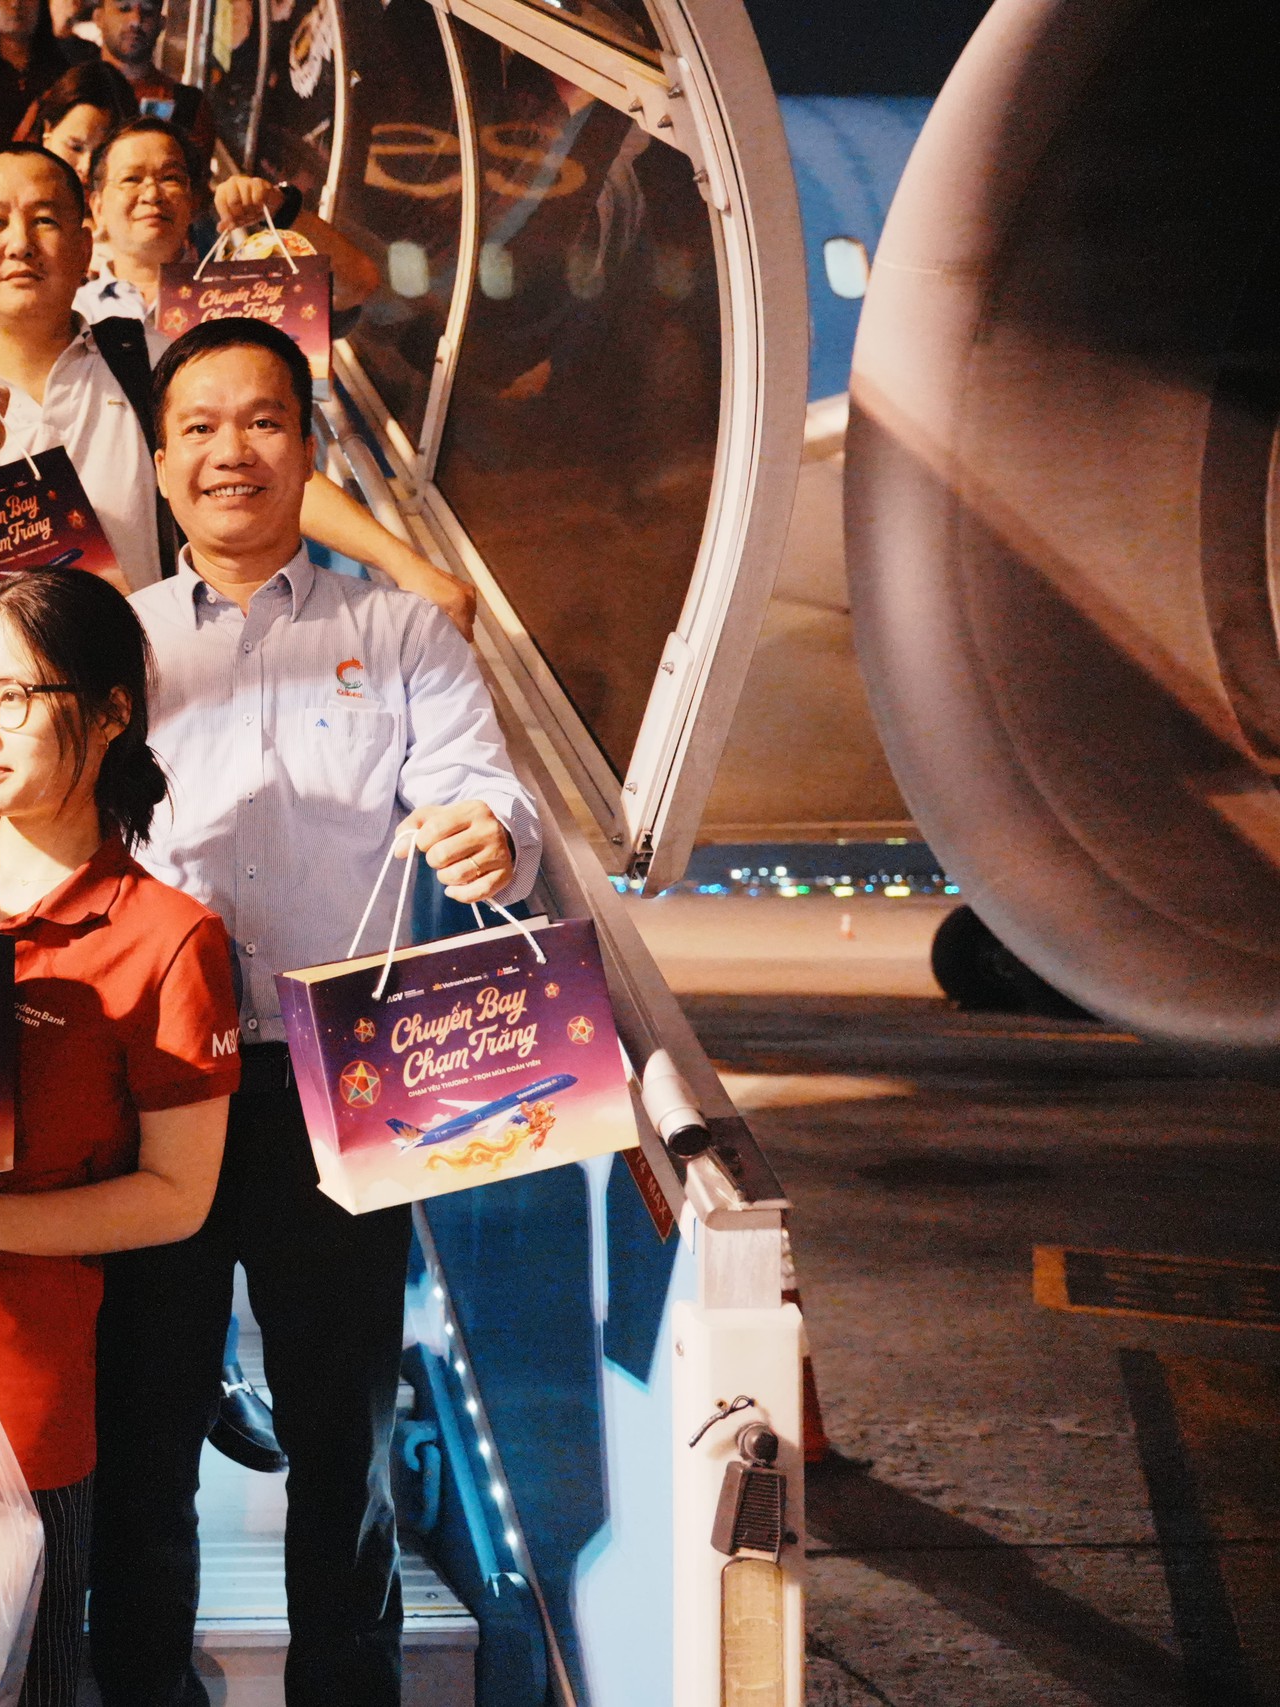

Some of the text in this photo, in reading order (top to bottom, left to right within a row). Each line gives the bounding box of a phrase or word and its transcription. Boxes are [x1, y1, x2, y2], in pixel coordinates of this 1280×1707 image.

[251, 281, 283, 304] Bay
[5, 495, 40, 519] Bay
[8, 517, 53, 545] Trăng
[387, 992, 403, 1003] ACV
[14, 1002, 66, 1026] odernBank
[15, 1012, 40, 1028] tnam
[391, 987, 527, 1054] Chuyến Bay
[403, 1023, 538, 1088] Chạm Trăng
